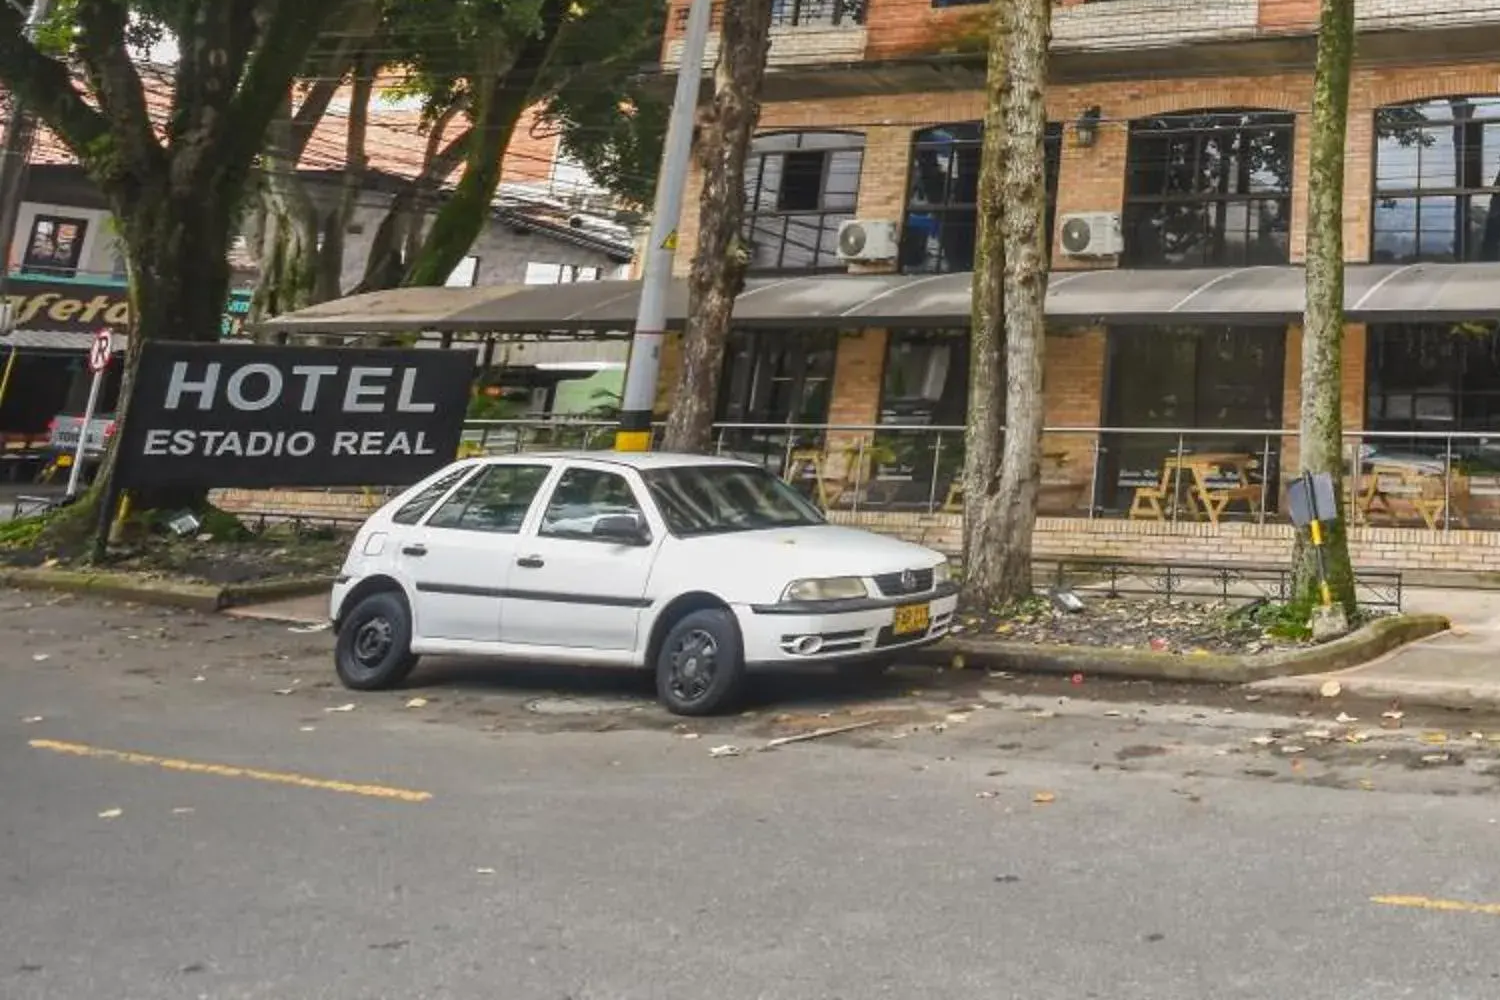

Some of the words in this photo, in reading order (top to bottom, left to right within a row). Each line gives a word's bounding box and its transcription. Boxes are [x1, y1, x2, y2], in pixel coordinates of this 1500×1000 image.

[163, 361, 436, 413] HOTEL
[143, 429, 316, 457] ESTADIO
[331, 431, 436, 456] REAL
